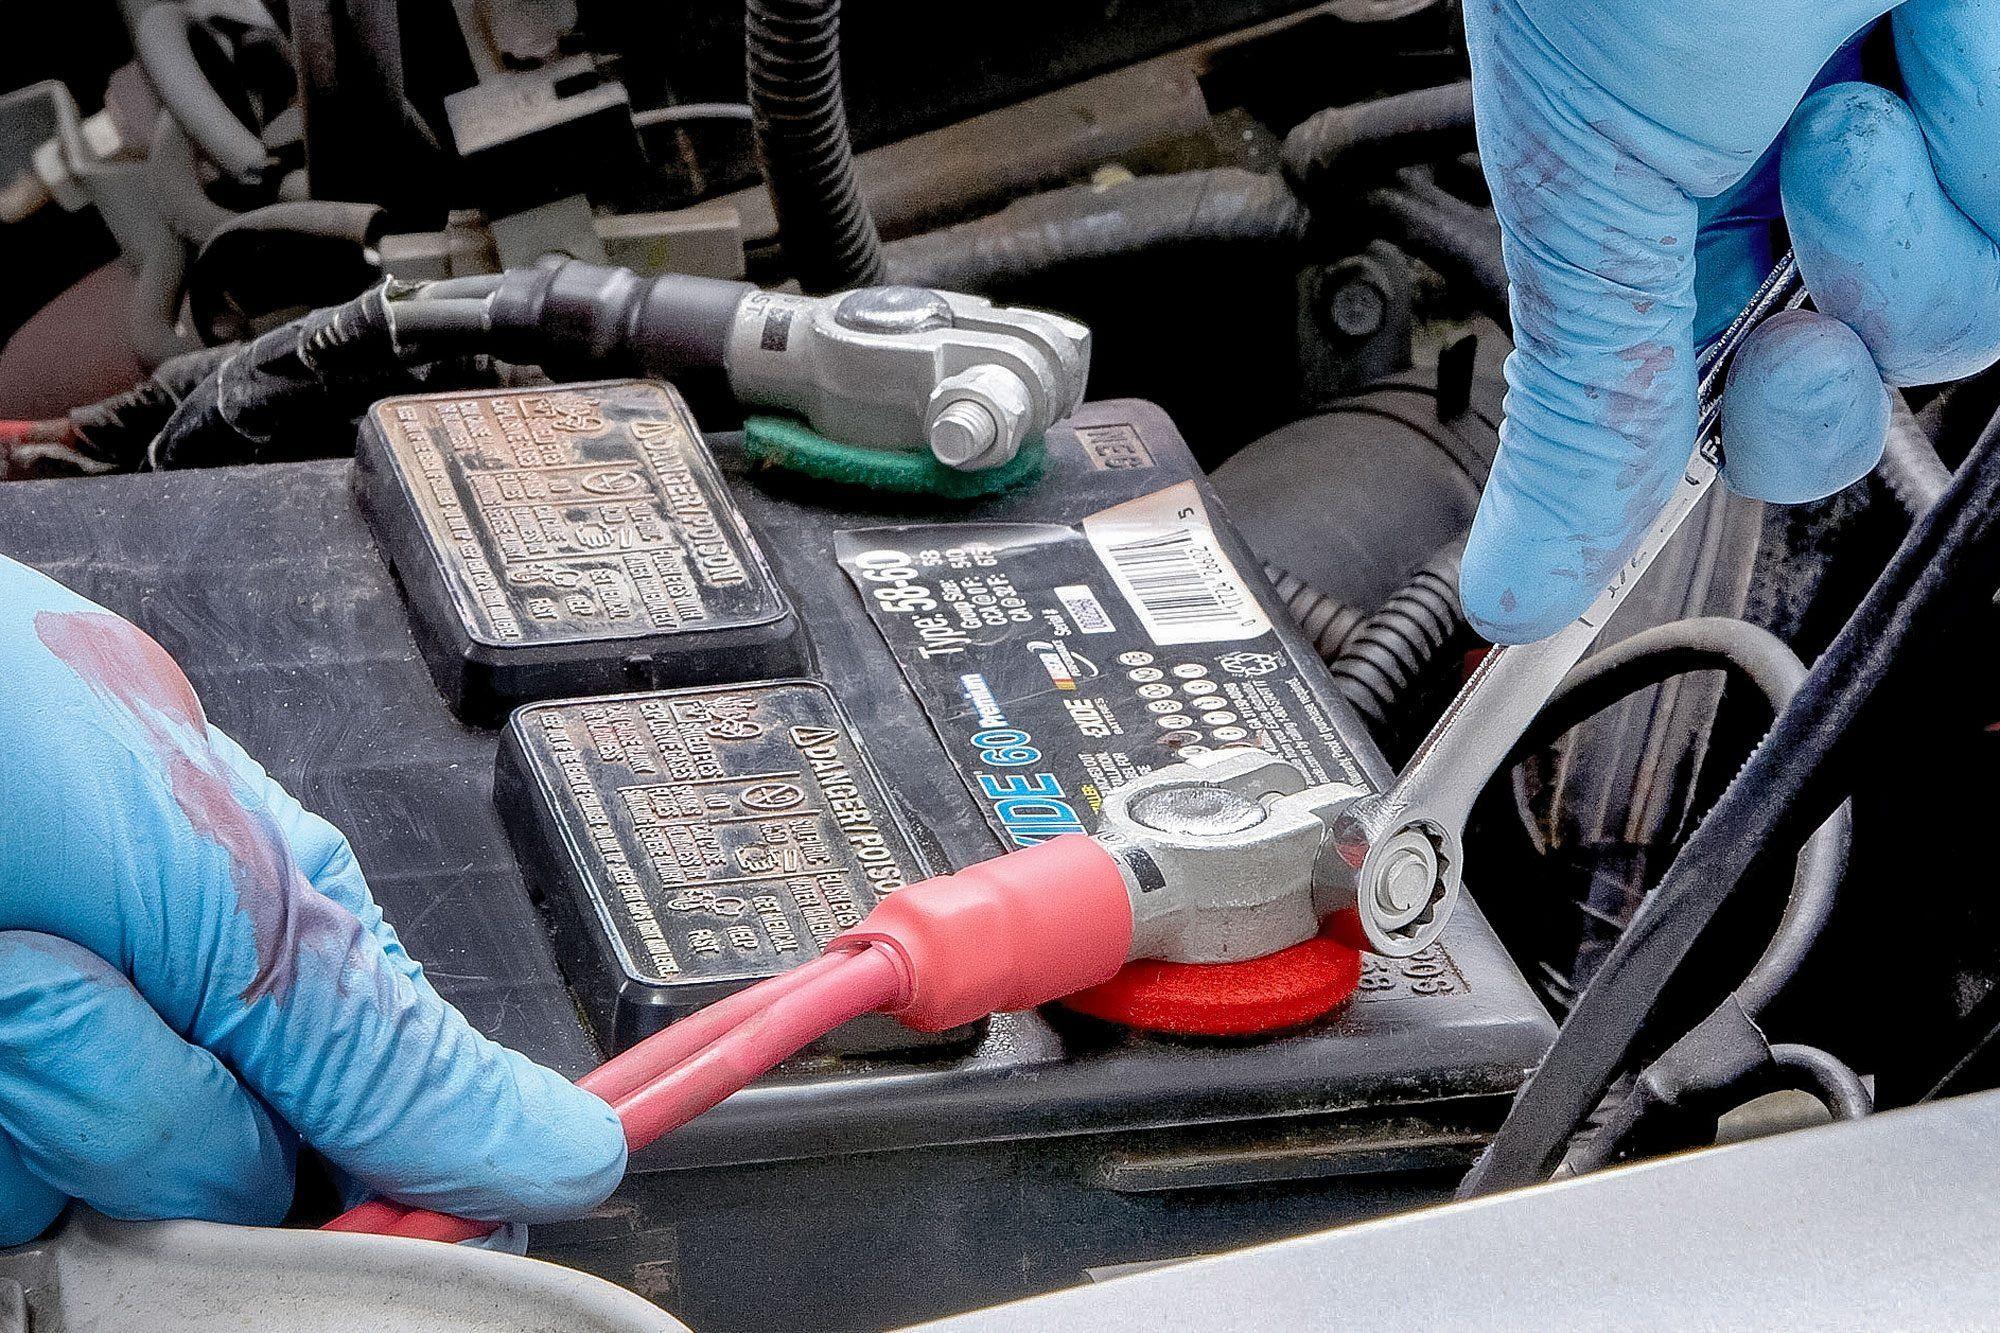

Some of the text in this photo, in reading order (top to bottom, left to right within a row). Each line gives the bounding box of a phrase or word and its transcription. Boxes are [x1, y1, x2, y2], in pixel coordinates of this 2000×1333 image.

[1086, 430, 1142, 469] NEG
[638, 438, 747, 582] DANGER/POISON
[1178, 507, 1194, 519] 5
[855, 549, 972, 659] Type: 58-60
[939, 580, 965, 601] Size:
[953, 601, 982, 629] Group
[979, 605, 1008, 625] CCA
[1008, 607, 1033, 621] CA
[1044, 615, 1071, 636] Serial
[1063, 699, 1111, 738] EXIDE
[1094, 698, 1124, 734] BATTERIES
[636, 702, 700, 780] EXPLOSIVE GASES
[675, 722, 726, 777] SHIELD EYES
[960, 673, 1087, 847] IDE 60 Premium
[801, 746, 909, 897] DANGER/POISO
[786, 818, 833, 863] SULFURIC
[749, 894, 782, 913] GET
[813, 872, 868, 928] FLUSH EYES
[684, 928, 721, 954] FAST
[724, 924, 760, 950] HELP
